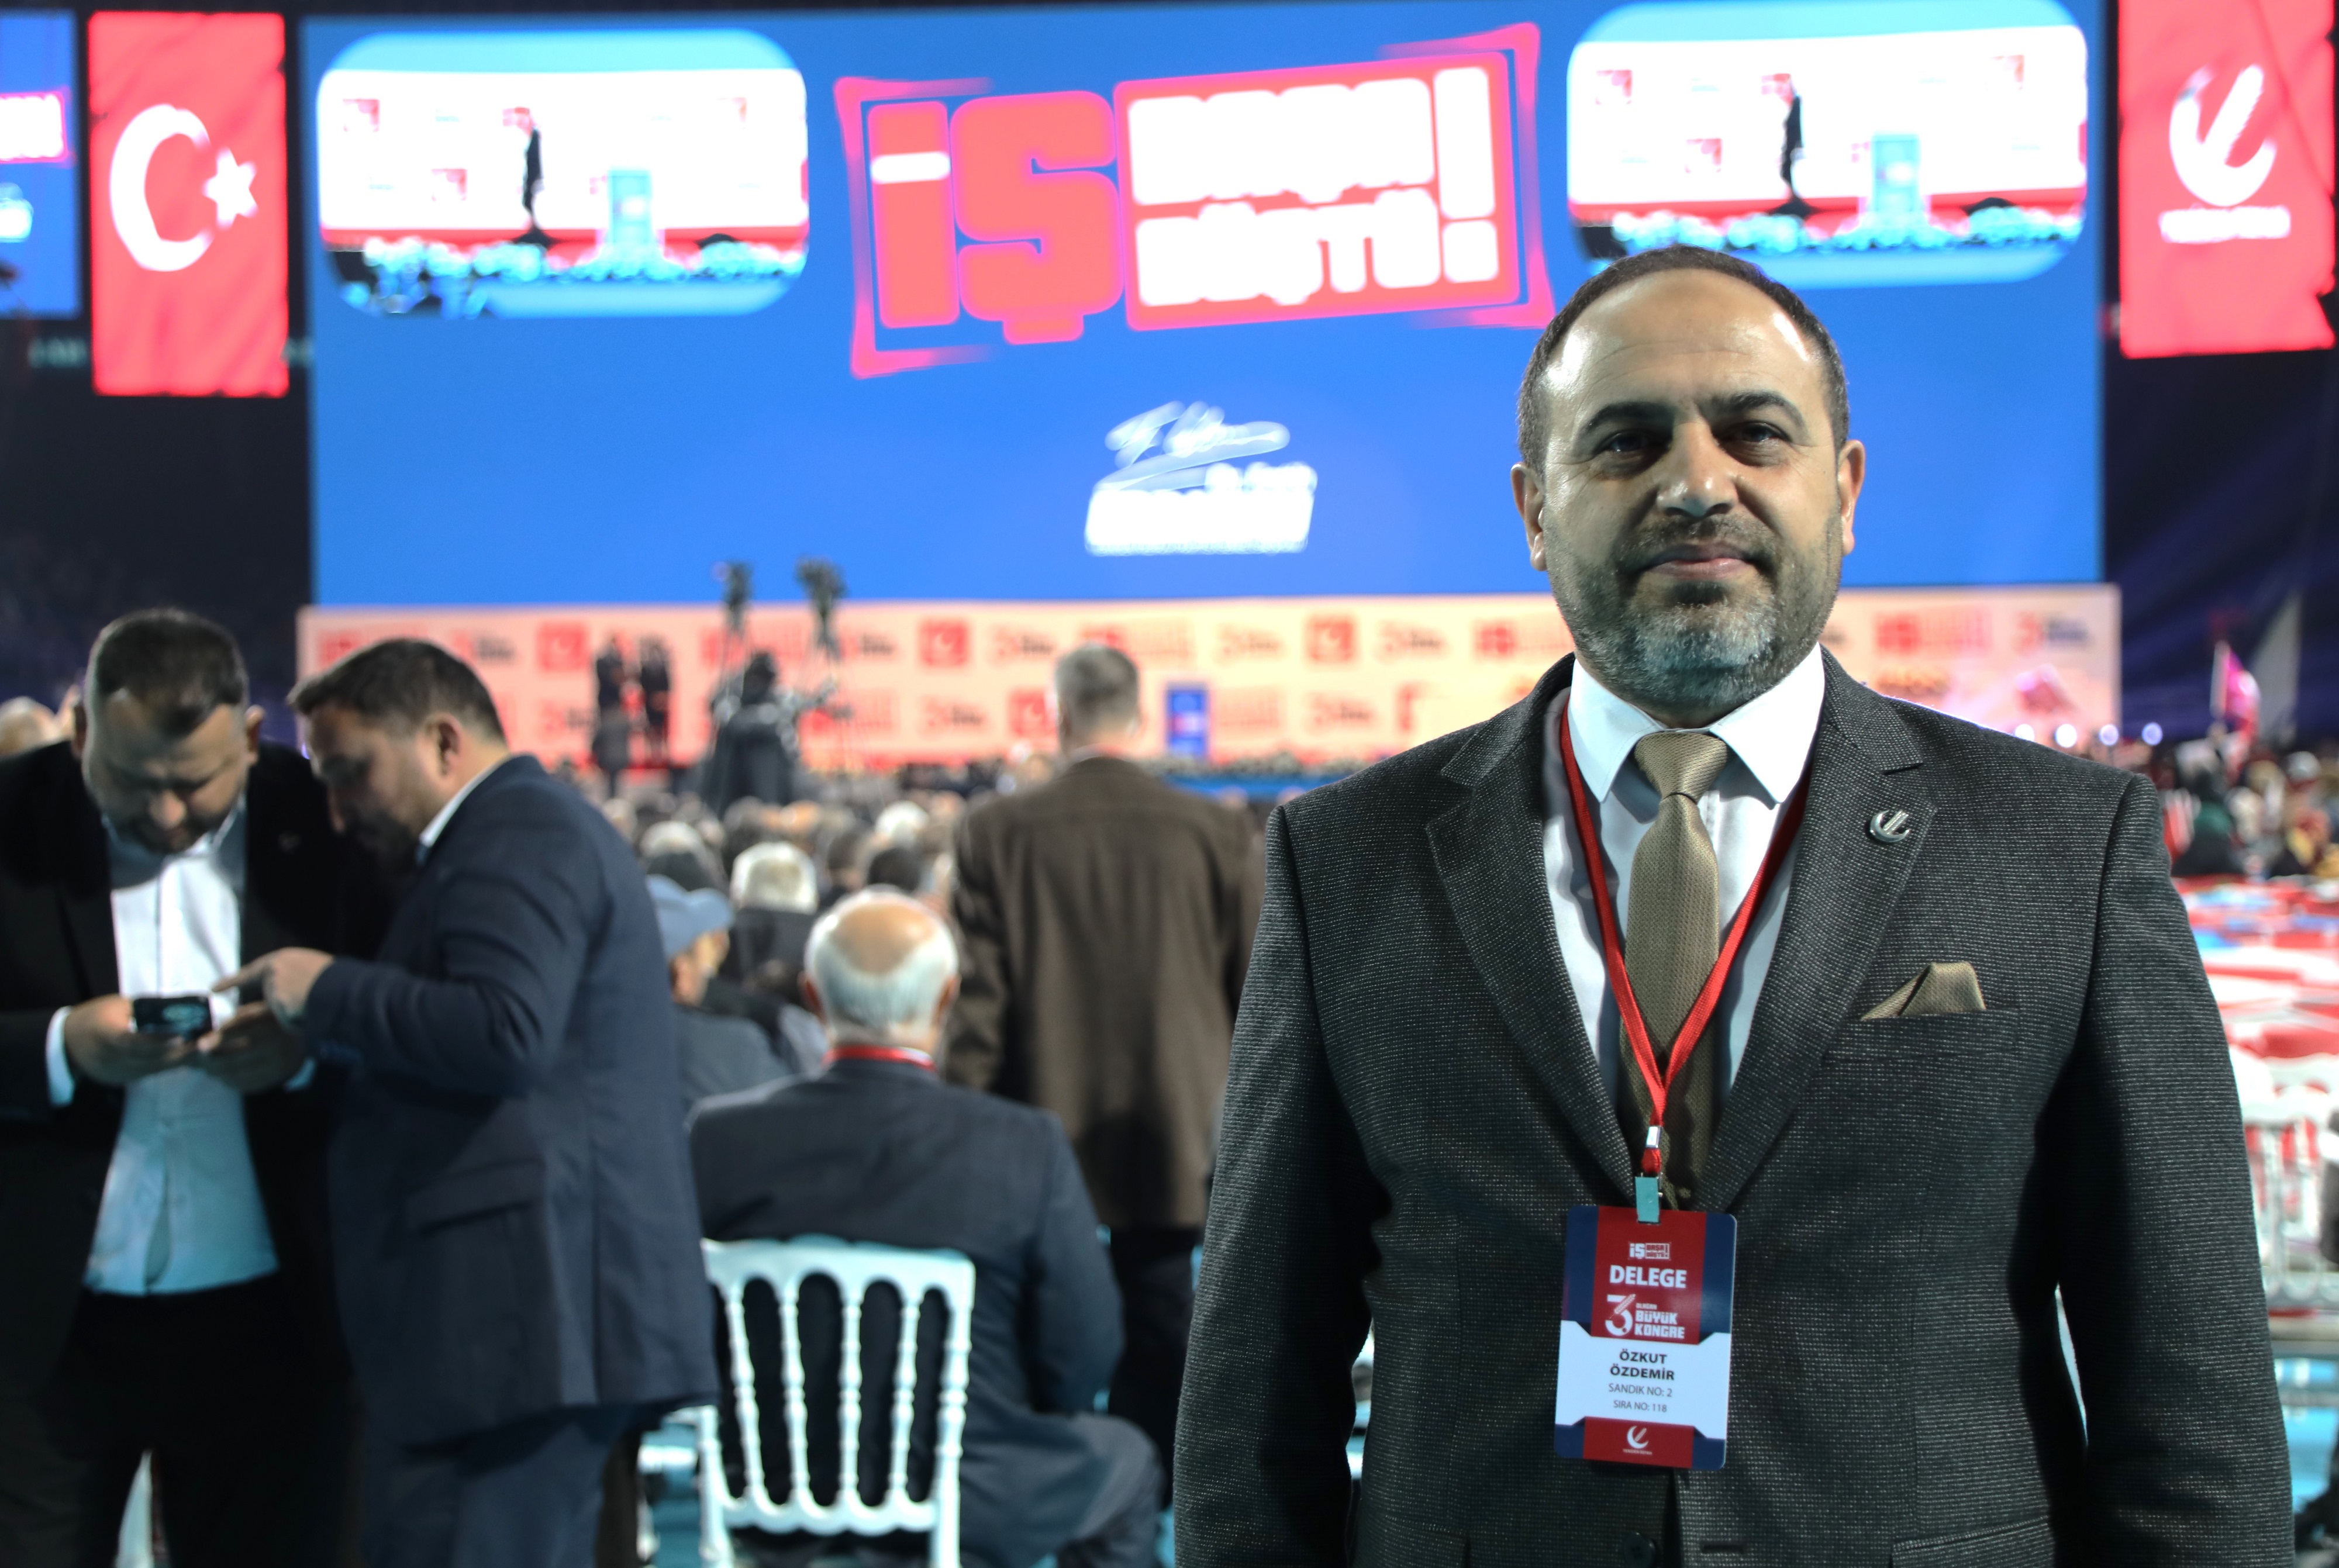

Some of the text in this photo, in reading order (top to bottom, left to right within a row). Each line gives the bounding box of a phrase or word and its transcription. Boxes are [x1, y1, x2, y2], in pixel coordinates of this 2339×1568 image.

[1609, 1265, 1687, 1289] DELEGE
[1635, 1310, 1678, 1325] BÜYÜK
[1634, 1323, 1685, 1339] KONGRE
[1619, 1348, 1667, 1364] ÖZKUT
[1610, 1363, 1675, 1380] ÖZDEMİR
[1609, 1383, 1672, 1397] SANDIK NO: 2
[1613, 1400, 1667, 1412] SIRA NO: 118
